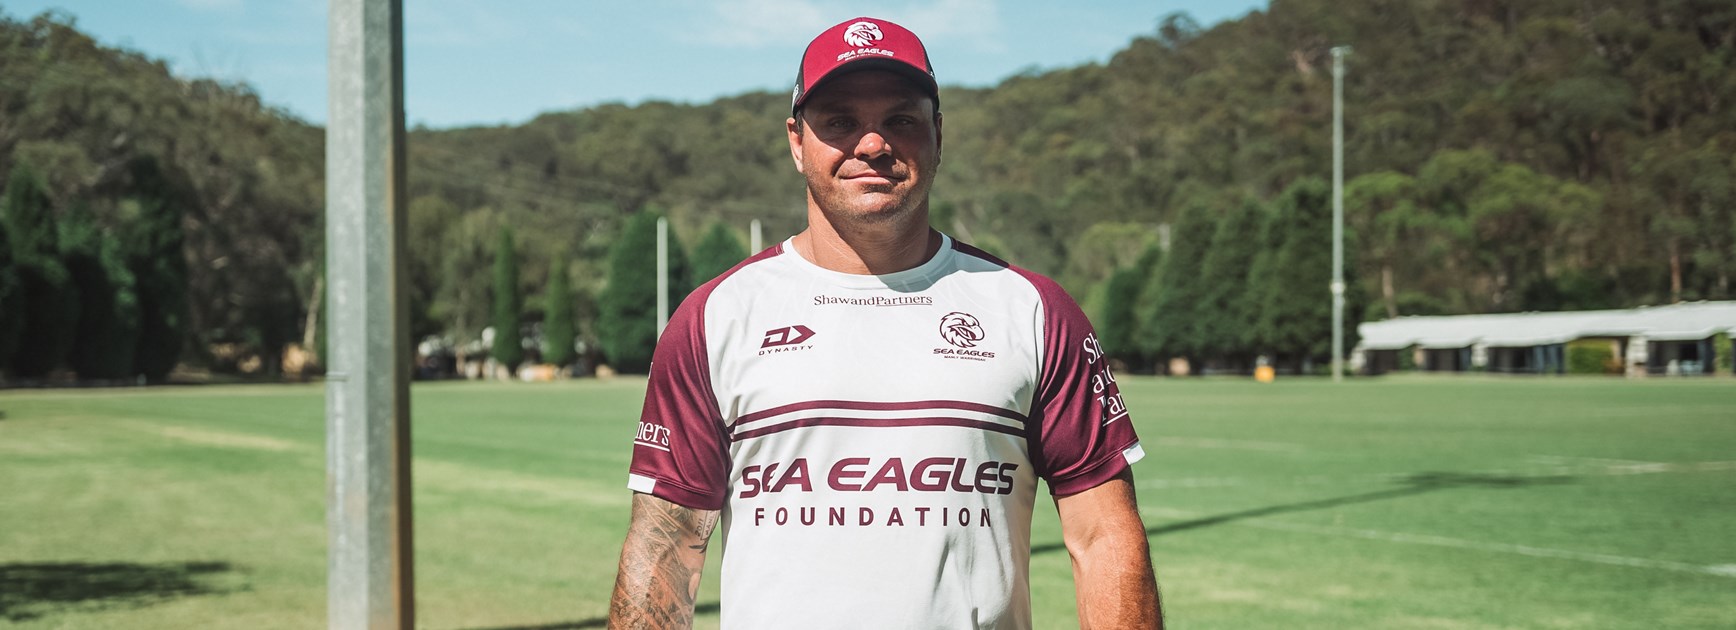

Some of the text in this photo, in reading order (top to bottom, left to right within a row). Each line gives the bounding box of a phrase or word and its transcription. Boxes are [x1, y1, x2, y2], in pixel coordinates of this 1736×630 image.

[837, 50, 856, 61] SEA
[857, 48, 894, 57] EAGLES
[758, 345, 813, 356] DYNASTY
[956, 349, 995, 358] EAGLES
[739, 457, 1019, 499] SEA EAGLES
[755, 507, 991, 527] FOUNDATION
